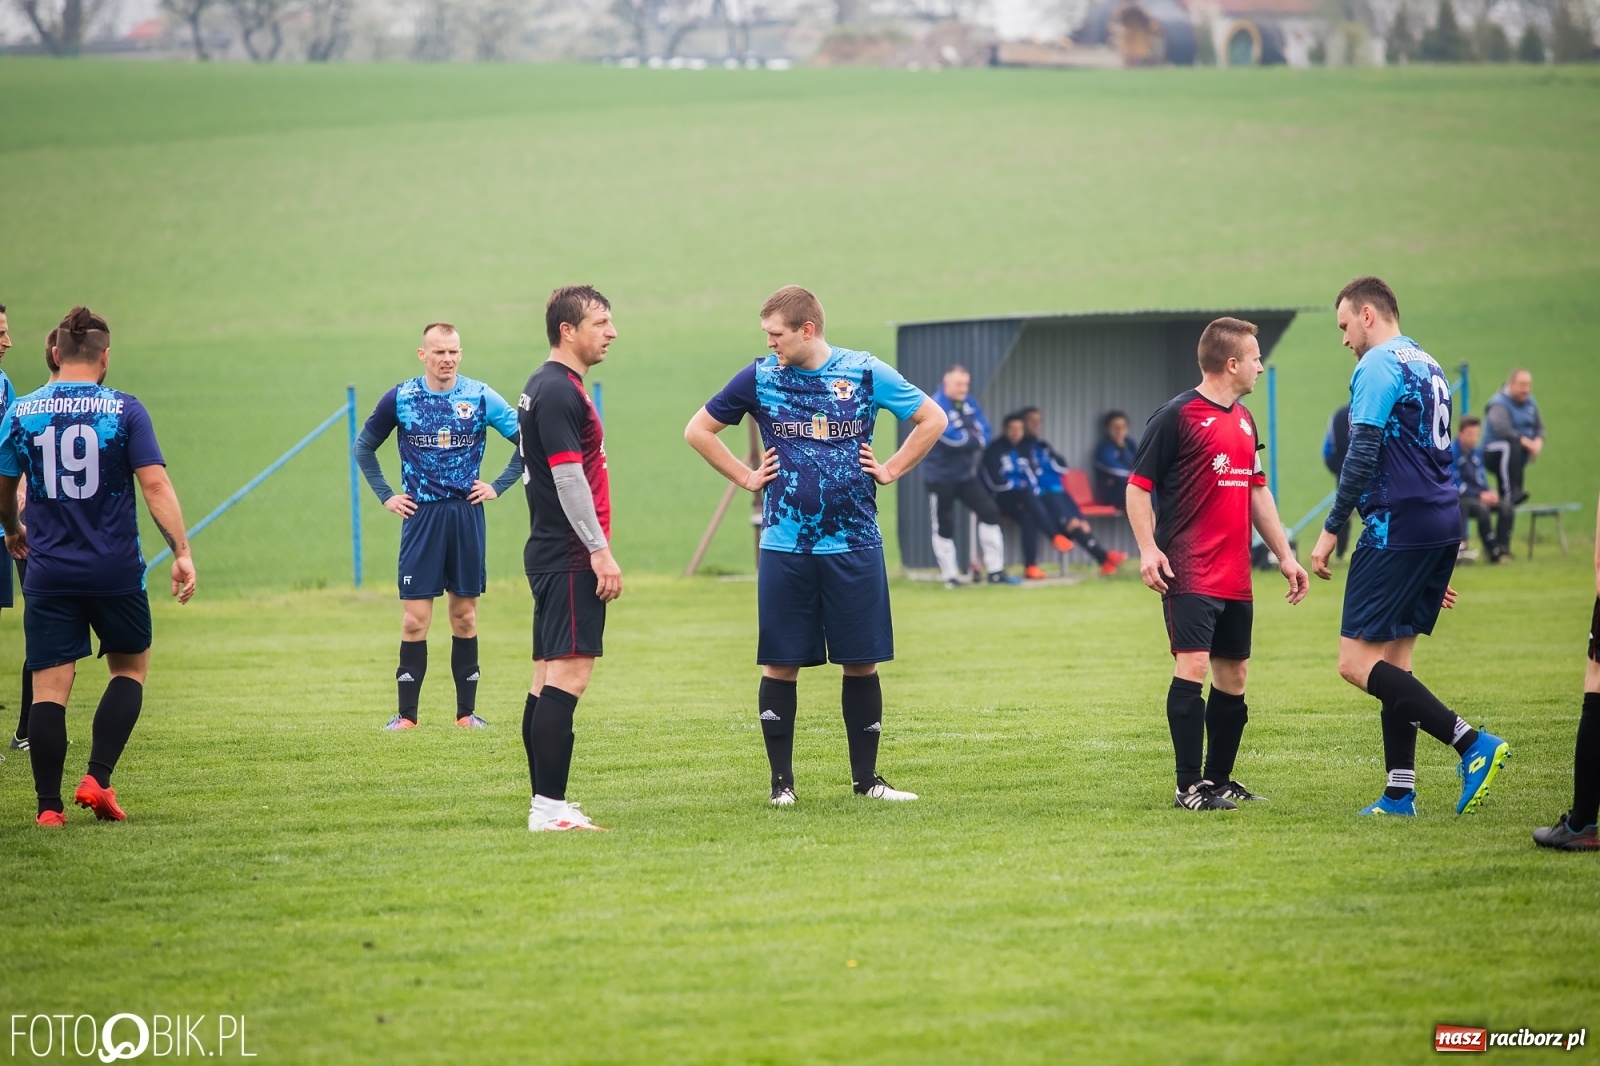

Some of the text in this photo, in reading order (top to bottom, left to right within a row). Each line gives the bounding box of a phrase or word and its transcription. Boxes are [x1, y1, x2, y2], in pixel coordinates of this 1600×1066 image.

[15, 396, 125, 418] GRZEGORZOWICE
[772, 412, 862, 440] REICHBAU
[1431, 374, 1451, 451] 6
[33, 424, 100, 500] 19
